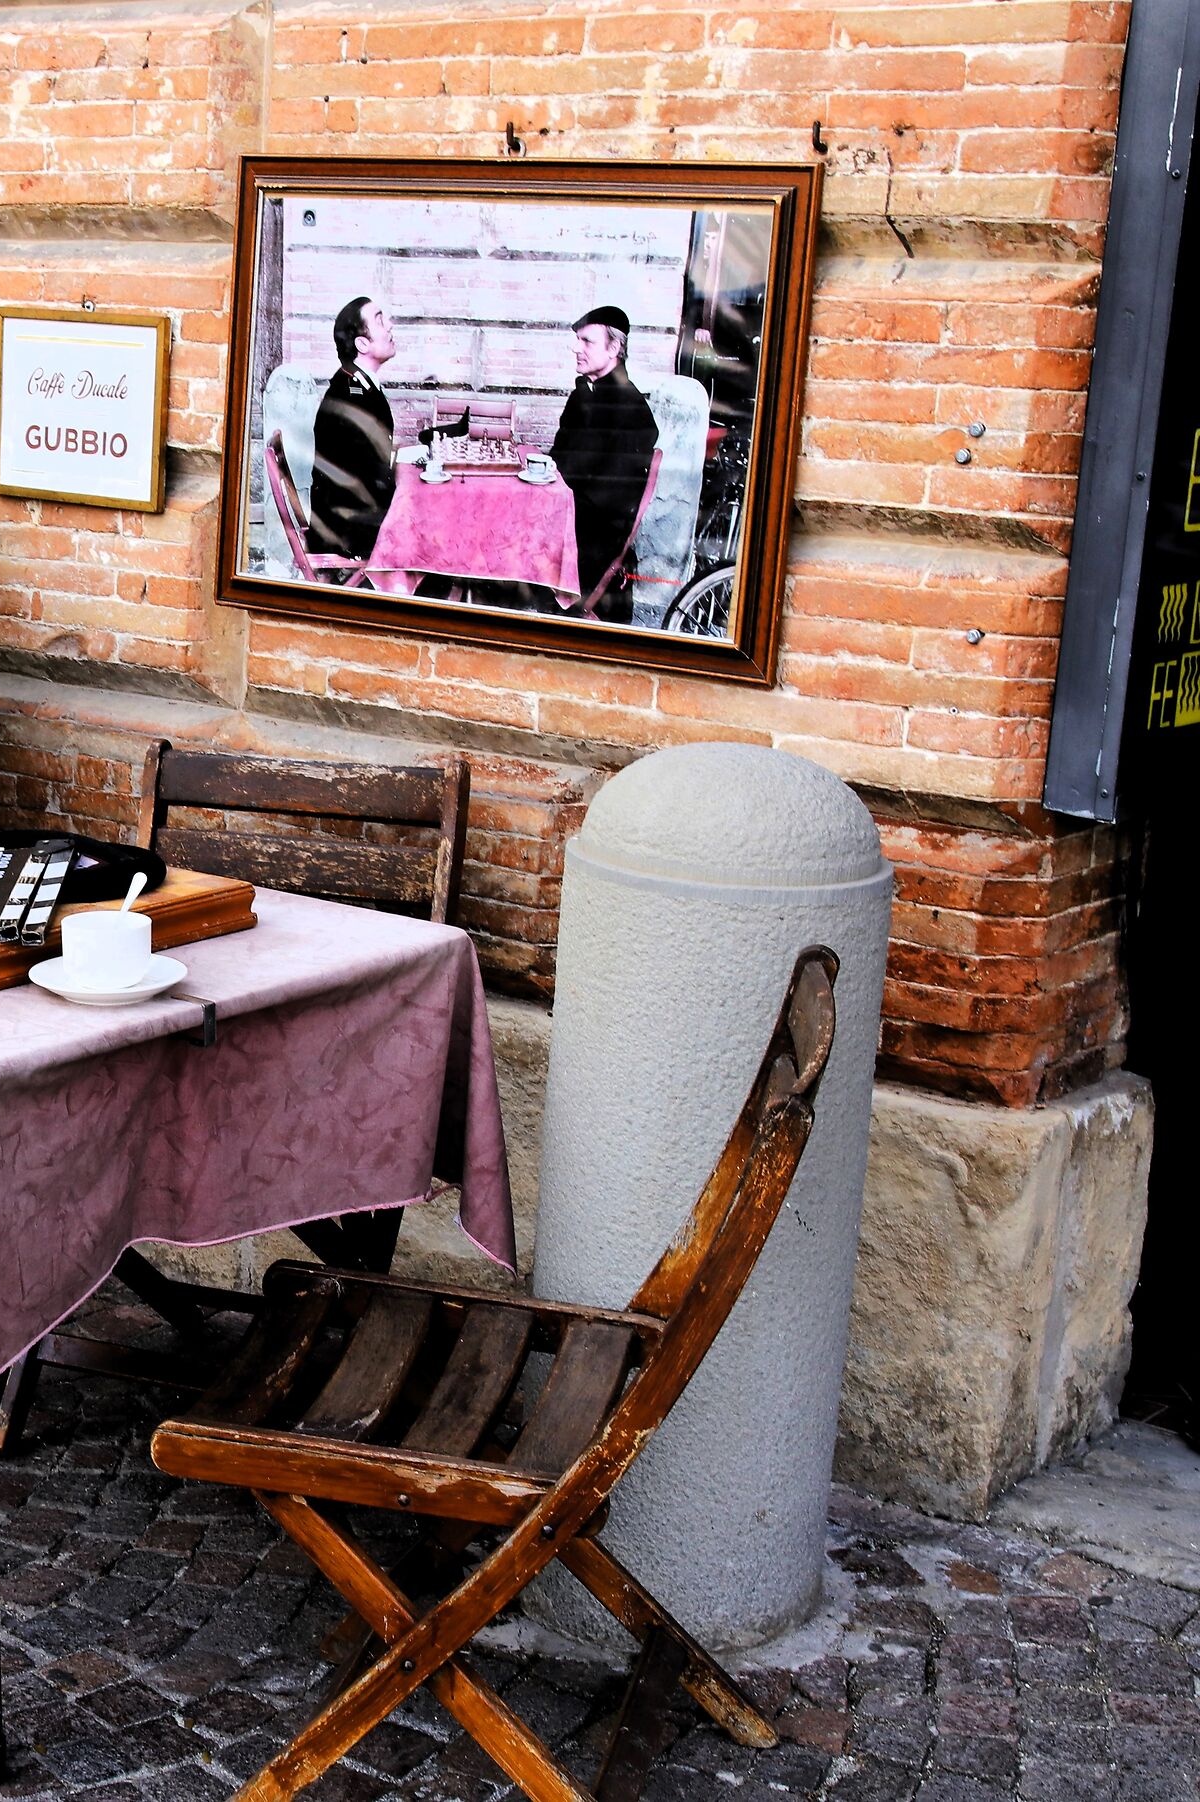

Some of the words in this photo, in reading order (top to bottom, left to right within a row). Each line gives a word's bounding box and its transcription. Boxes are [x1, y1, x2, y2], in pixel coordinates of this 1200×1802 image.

[27, 367, 65, 399] Caffè
[71, 369, 129, 400] Ducale
[25, 424, 128, 458] GUBBIO
